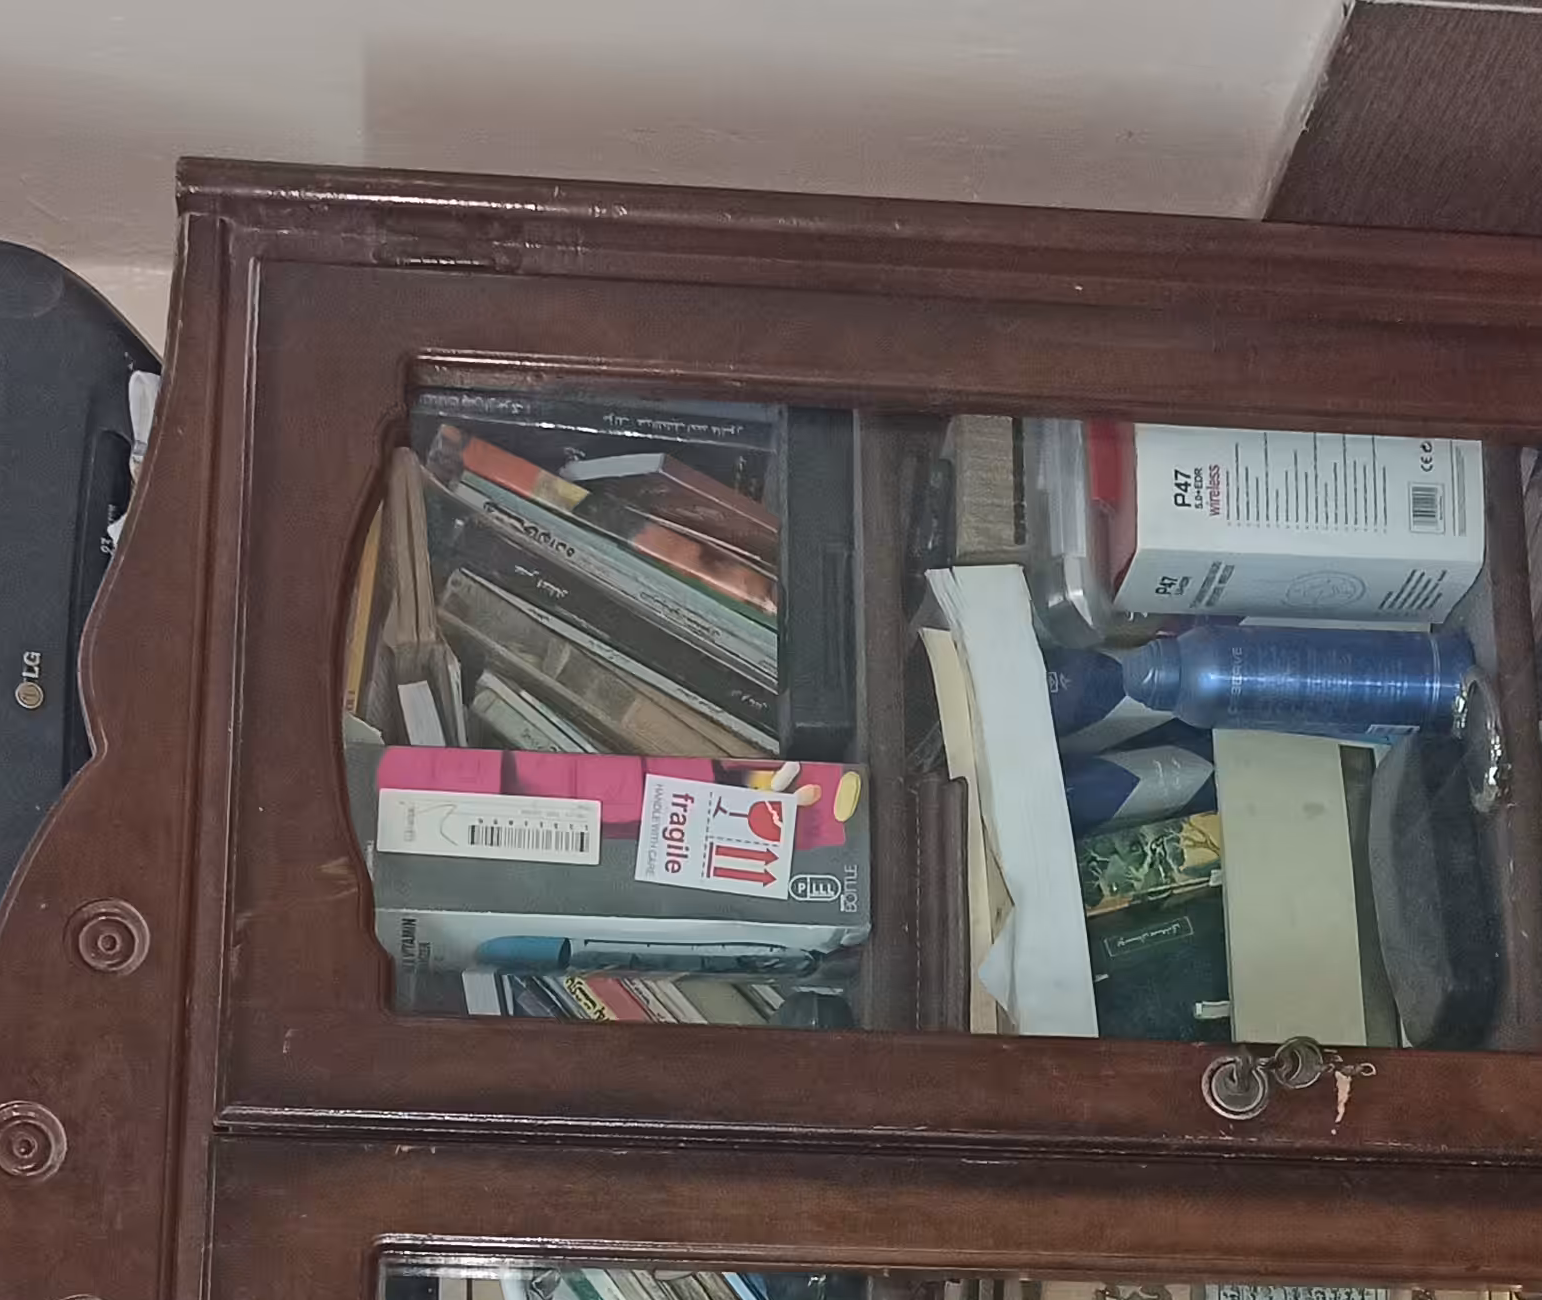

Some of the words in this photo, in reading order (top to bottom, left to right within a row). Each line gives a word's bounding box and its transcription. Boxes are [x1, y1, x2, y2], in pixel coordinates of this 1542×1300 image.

[1173, 468, 1192, 508] P47
[1206, 464, 1222, 517] wireless
[1154, 575, 1178, 596] P47
[20, 651, 42, 678] LG
[662, 792, 695, 875] fragile
